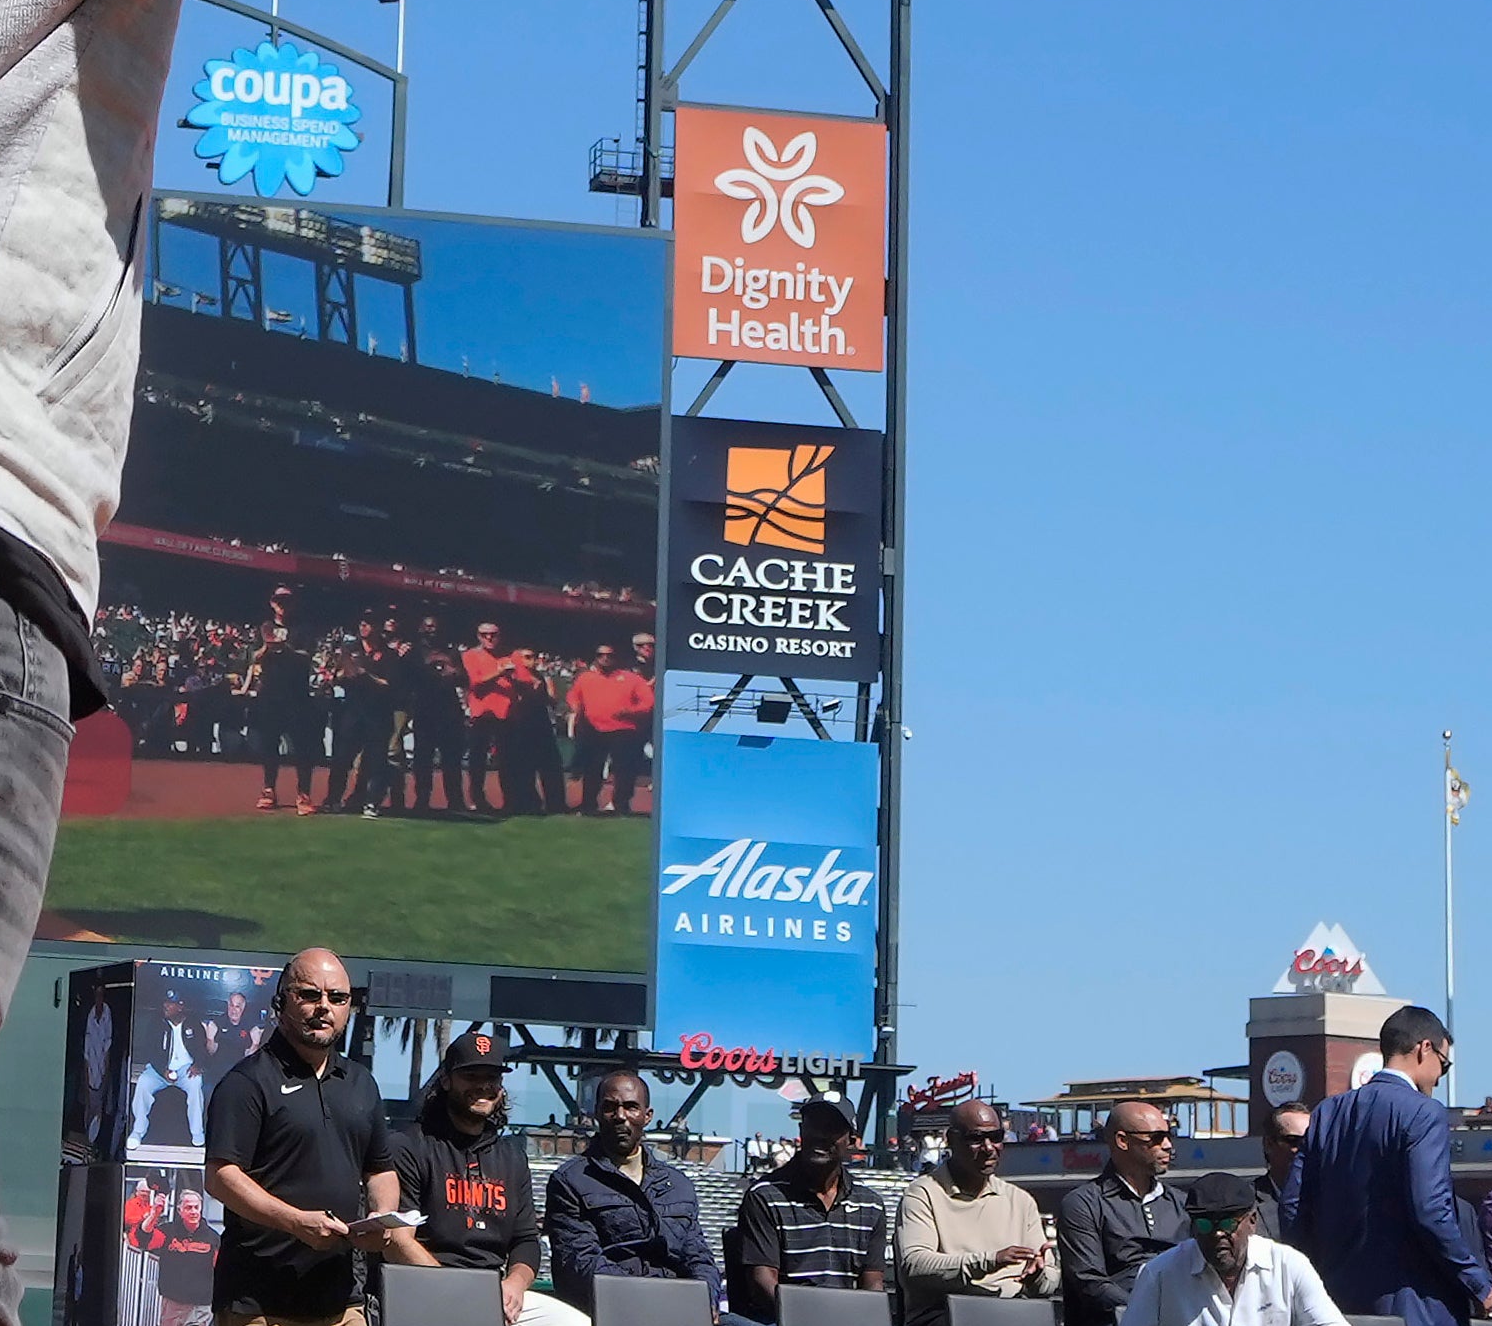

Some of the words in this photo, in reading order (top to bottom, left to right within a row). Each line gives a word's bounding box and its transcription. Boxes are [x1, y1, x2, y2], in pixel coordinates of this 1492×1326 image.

[210, 67, 348, 117] coupa
[220, 112, 290, 130] BUSINESS
[292, 119, 340, 134] SPEND
[227, 128, 331, 148] MANAGEMENT
[701, 255, 853, 316] Dignity
[707, 308, 846, 355] Health
[690, 554, 856, 595] CACHE
[694, 591, 851, 632] CREEK
[688, 632, 769, 655] CASINO
[775, 638, 856, 659] RESORT
[661, 838, 874, 913] Alaska
[675, 912, 852, 942] AIRLINES
[1294, 949, 1365, 974] Coors
[679, 1032, 778, 1073] Coors
[781, 1050, 865, 1076] LIGHT
[445, 1178, 507, 1211] GIANTS
